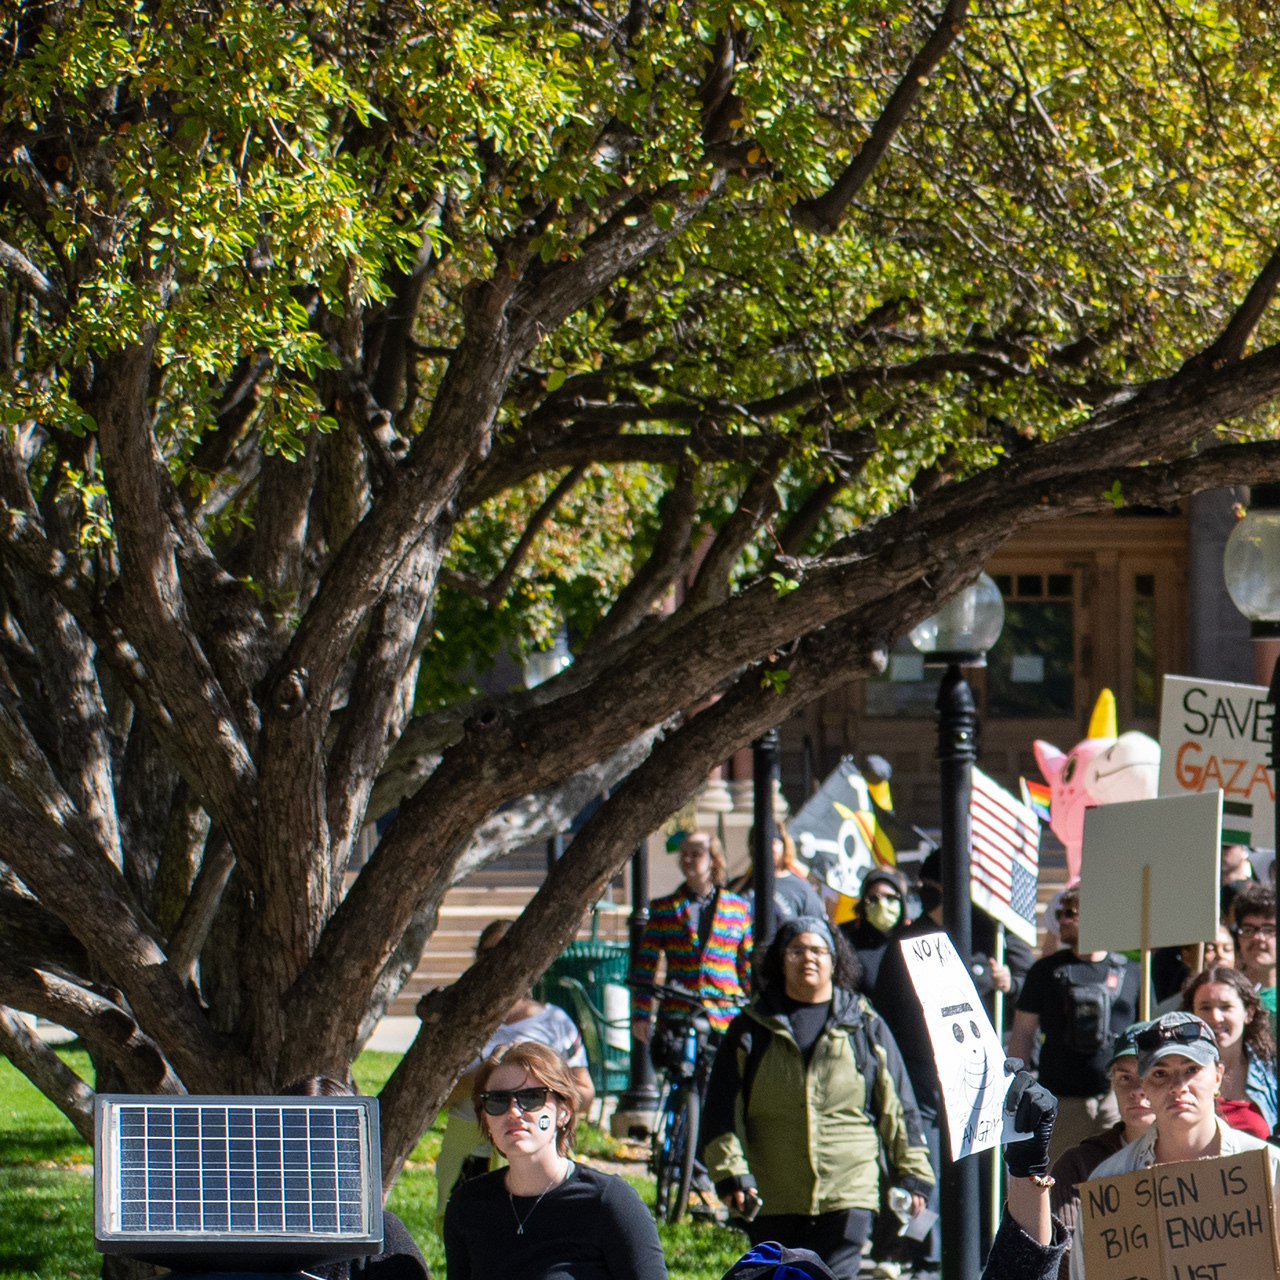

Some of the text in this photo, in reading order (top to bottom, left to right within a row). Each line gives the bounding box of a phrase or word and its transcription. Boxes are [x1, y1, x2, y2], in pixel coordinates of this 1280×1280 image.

[1183, 688, 1275, 744] SAVE
[1175, 741, 1276, 802] GAZA
[913, 939, 932, 961] NO
[1089, 1166, 1248, 1219] NO SIGN IS
[1100, 1205, 1263, 1259] BIG ENOUGH
